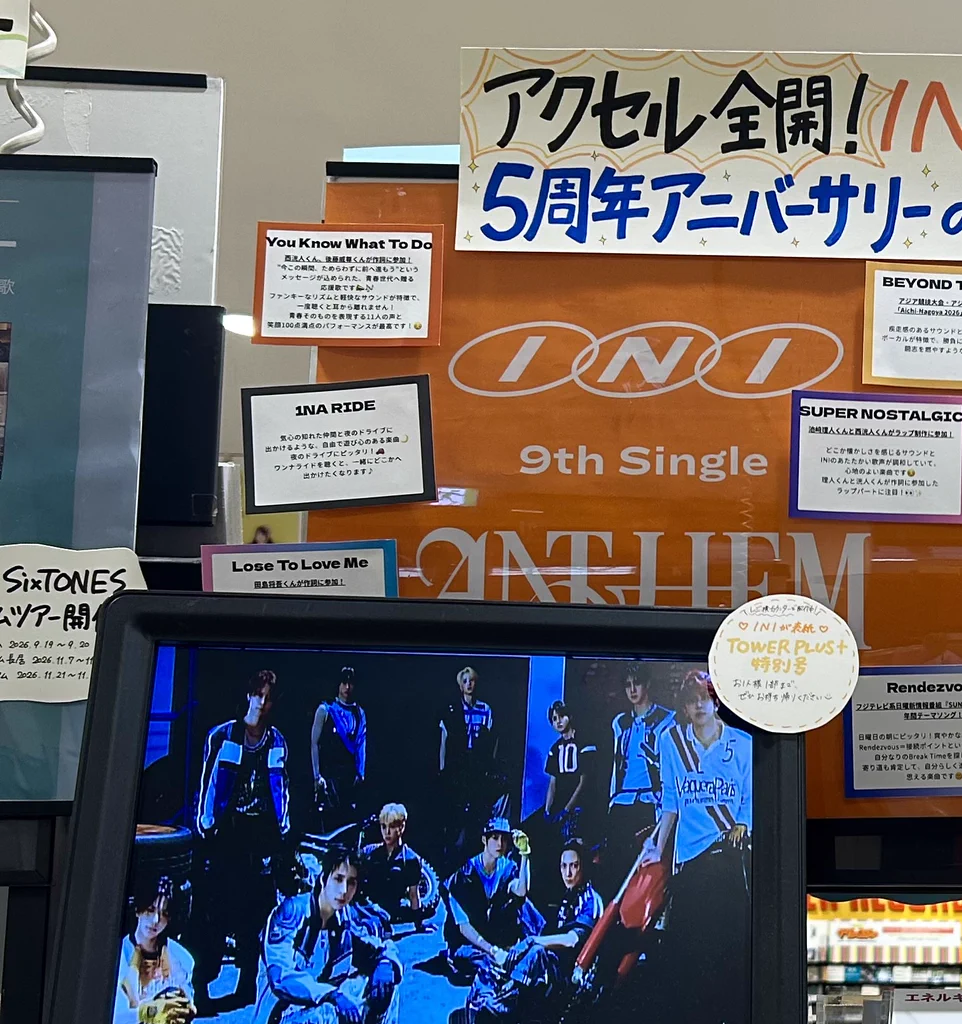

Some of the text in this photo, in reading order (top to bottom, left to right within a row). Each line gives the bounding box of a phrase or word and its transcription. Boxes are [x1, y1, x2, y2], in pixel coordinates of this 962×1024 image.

[266, 237, 433, 250] You Know What To Do
[882, 276, 953, 290] BEYOND
[295, 400, 376, 416] 1NA RIDE
[800, 406, 859, 419] SUPER
[519, 444, 769, 483] 9th Single
[232, 557, 369, 572] Lose To Love Me
[3, 565, 127, 594] SixTONES
[727, 637, 790, 656] TOWER
[751, 656, 808, 675] 特別号
[558, 743, 578, 773] 10
[721, 739, 736, 762] 5
